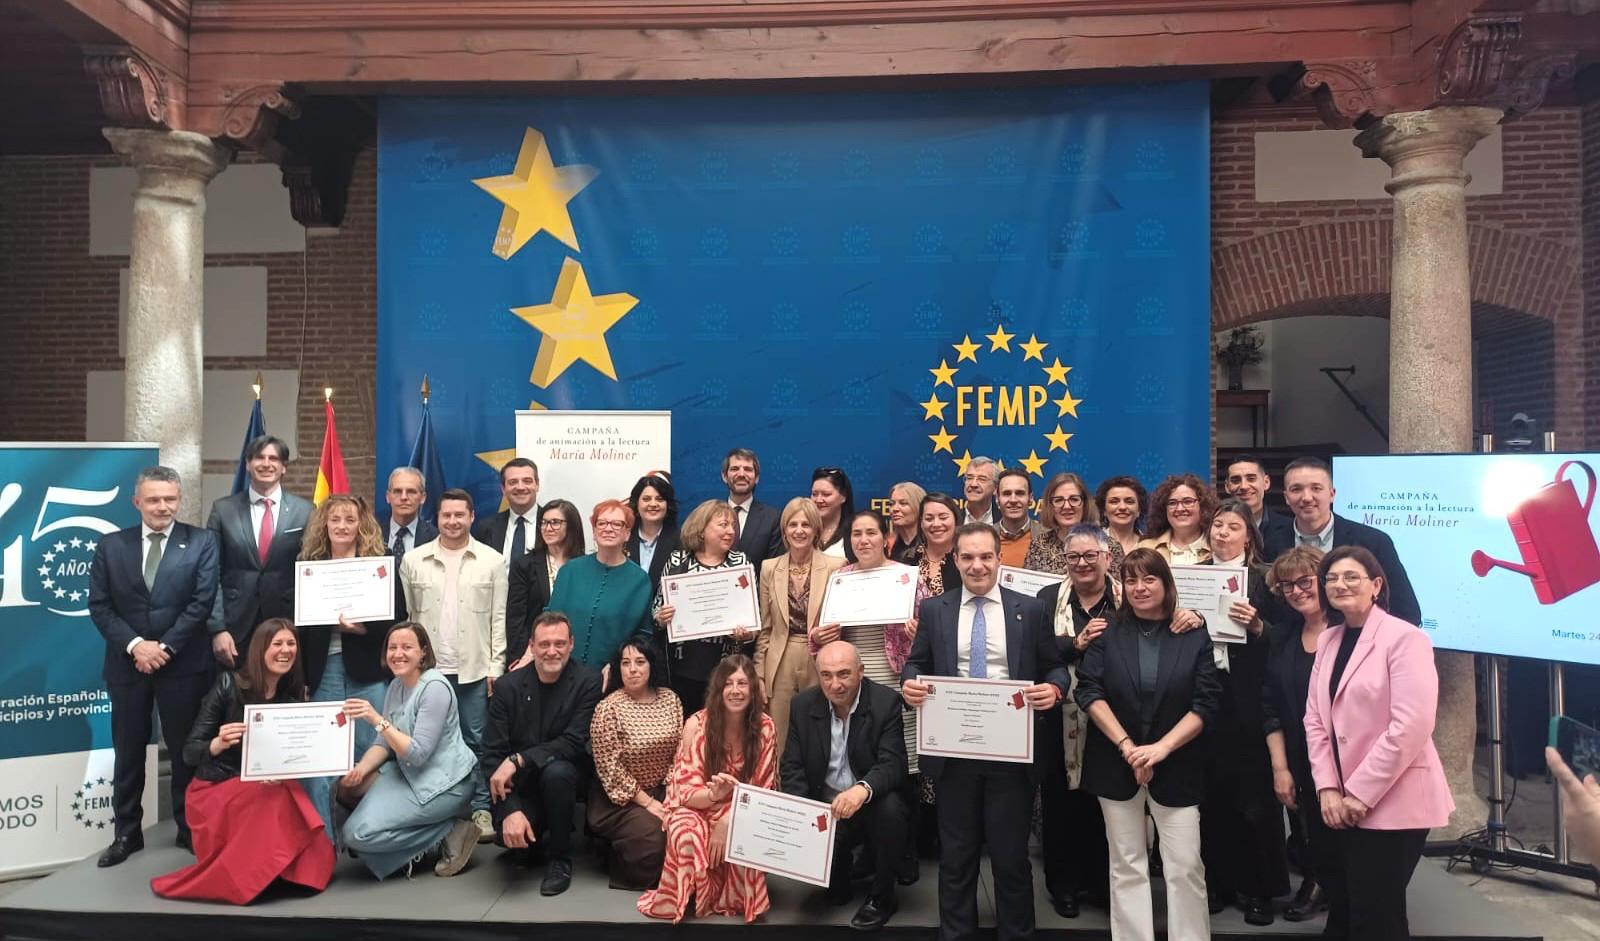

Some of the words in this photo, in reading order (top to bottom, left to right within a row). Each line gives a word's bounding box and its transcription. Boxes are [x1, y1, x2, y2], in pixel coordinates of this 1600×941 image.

[957, 386, 1048, 426] FEMP
[567, 426, 620, 435] CAMPAÑA
[536, 437, 547, 445] de
[549, 438, 597, 446] animación
[608, 437, 616, 446] la
[618, 437, 650, 446] lectura
[550, 448, 585, 460] María
[590, 448, 637, 460] Moliner
[1380, 491, 1439, 500] CAMPAÑA
[1347, 502, 1359, 510] de
[1361, 503, 1413, 511] animación
[1425, 503, 1434, 512] la
[1438, 503, 1475, 513] lectura
[1406, 514, 1459, 528] Moliner
[1551, 629, 1586, 640] Martes
[47, 689, 109, 706] Española
[46, 709, 55, 721] y
[58, 701, 113, 717] Provinci
[84, 796, 114, 810] FEM
